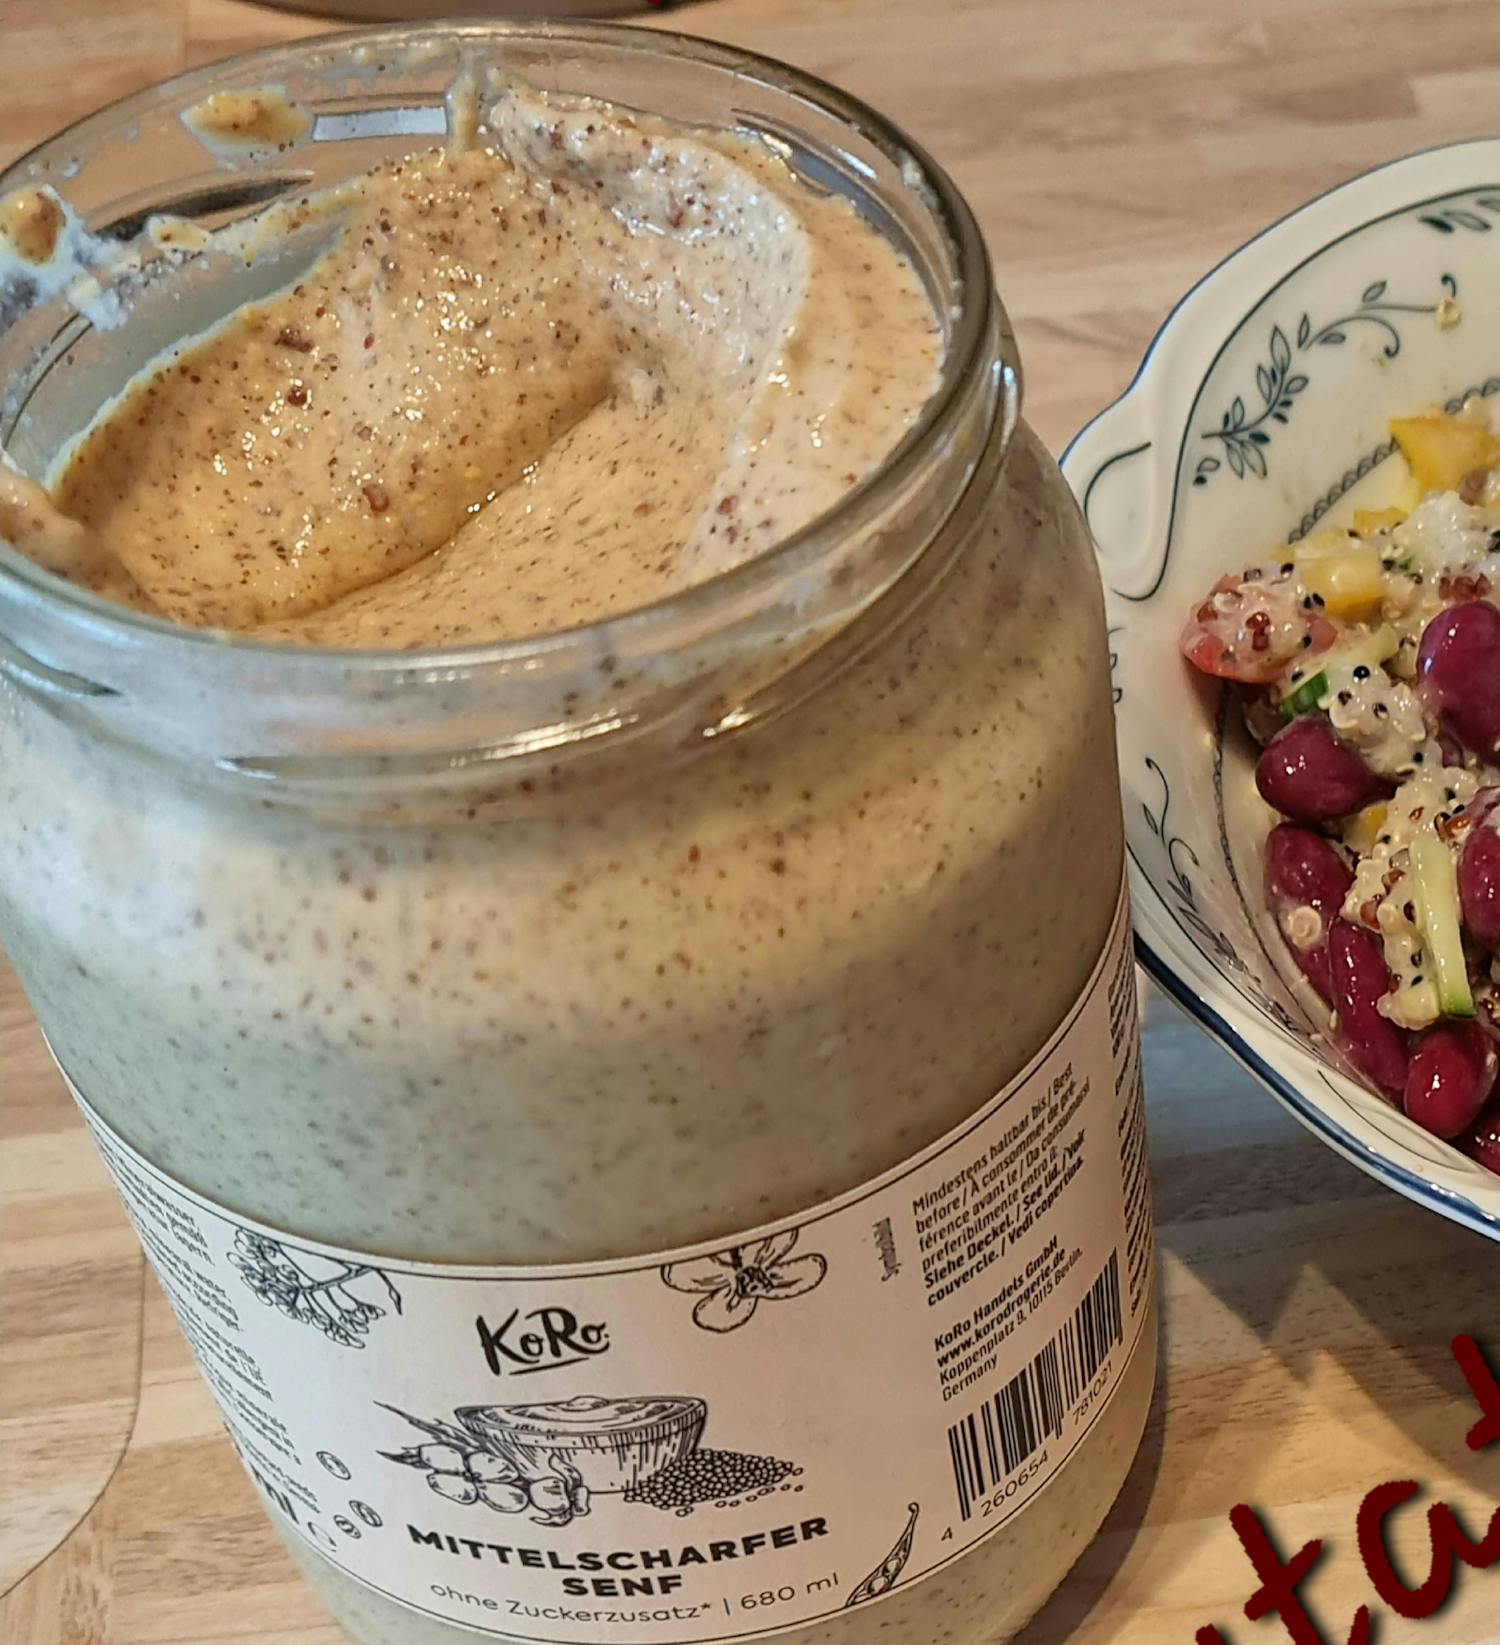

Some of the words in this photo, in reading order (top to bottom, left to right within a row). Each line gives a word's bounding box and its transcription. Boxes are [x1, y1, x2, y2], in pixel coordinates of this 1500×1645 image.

[912, 1154, 988, 1216] Mindestens
[989, 1114, 1029, 1162] haltbar
[1031, 1096, 1047, 1121] bis
[1053, 1061, 1073, 1095] Best
[915, 1193, 961, 1235] before
[982, 1118, 1046, 1187] consommer
[1047, 1100, 1059, 1125] de
[919, 1209, 970, 1253] férence
[972, 1185, 1006, 1218] avant
[1006, 1168, 1018, 1187] le
[1026, 1147, 1041, 1169] Da
[921, 1192, 1019, 1274] preferibilmente
[1020, 1158, 1049, 1194] entro
[923, 1252, 965, 1289] Siehe
[966, 1214, 1015, 1258] Deckel.
[1022, 1184, 1043, 1212] See
[928, 1251, 1000, 1307] couvercle.
[1008, 1210, 1034, 1246] Vedi
[934, 1319, 972, 1352] KoRo
[973, 1274, 1024, 1330] Handels
[1025, 1235, 1058, 1279] GmbH
[936, 1248, 1066, 1368] www.korodrogerie.de
[939, 1321, 1015, 1385] Koppenplatz
[1029, 1280, 1054, 1314] 10115
[943, 1353, 998, 1402] Germany
[940, 1526, 954, 1542] 4
[980, 1450, 1049, 1518] 260654
[407, 1516, 830, 1571] MITTELSCHARFER
[430, 1582, 499, 1611] ohne
[740, 1585, 797, 1611] 680
[806, 1571, 840, 1594] ml
[562, 1573, 686, 1598] SENF
